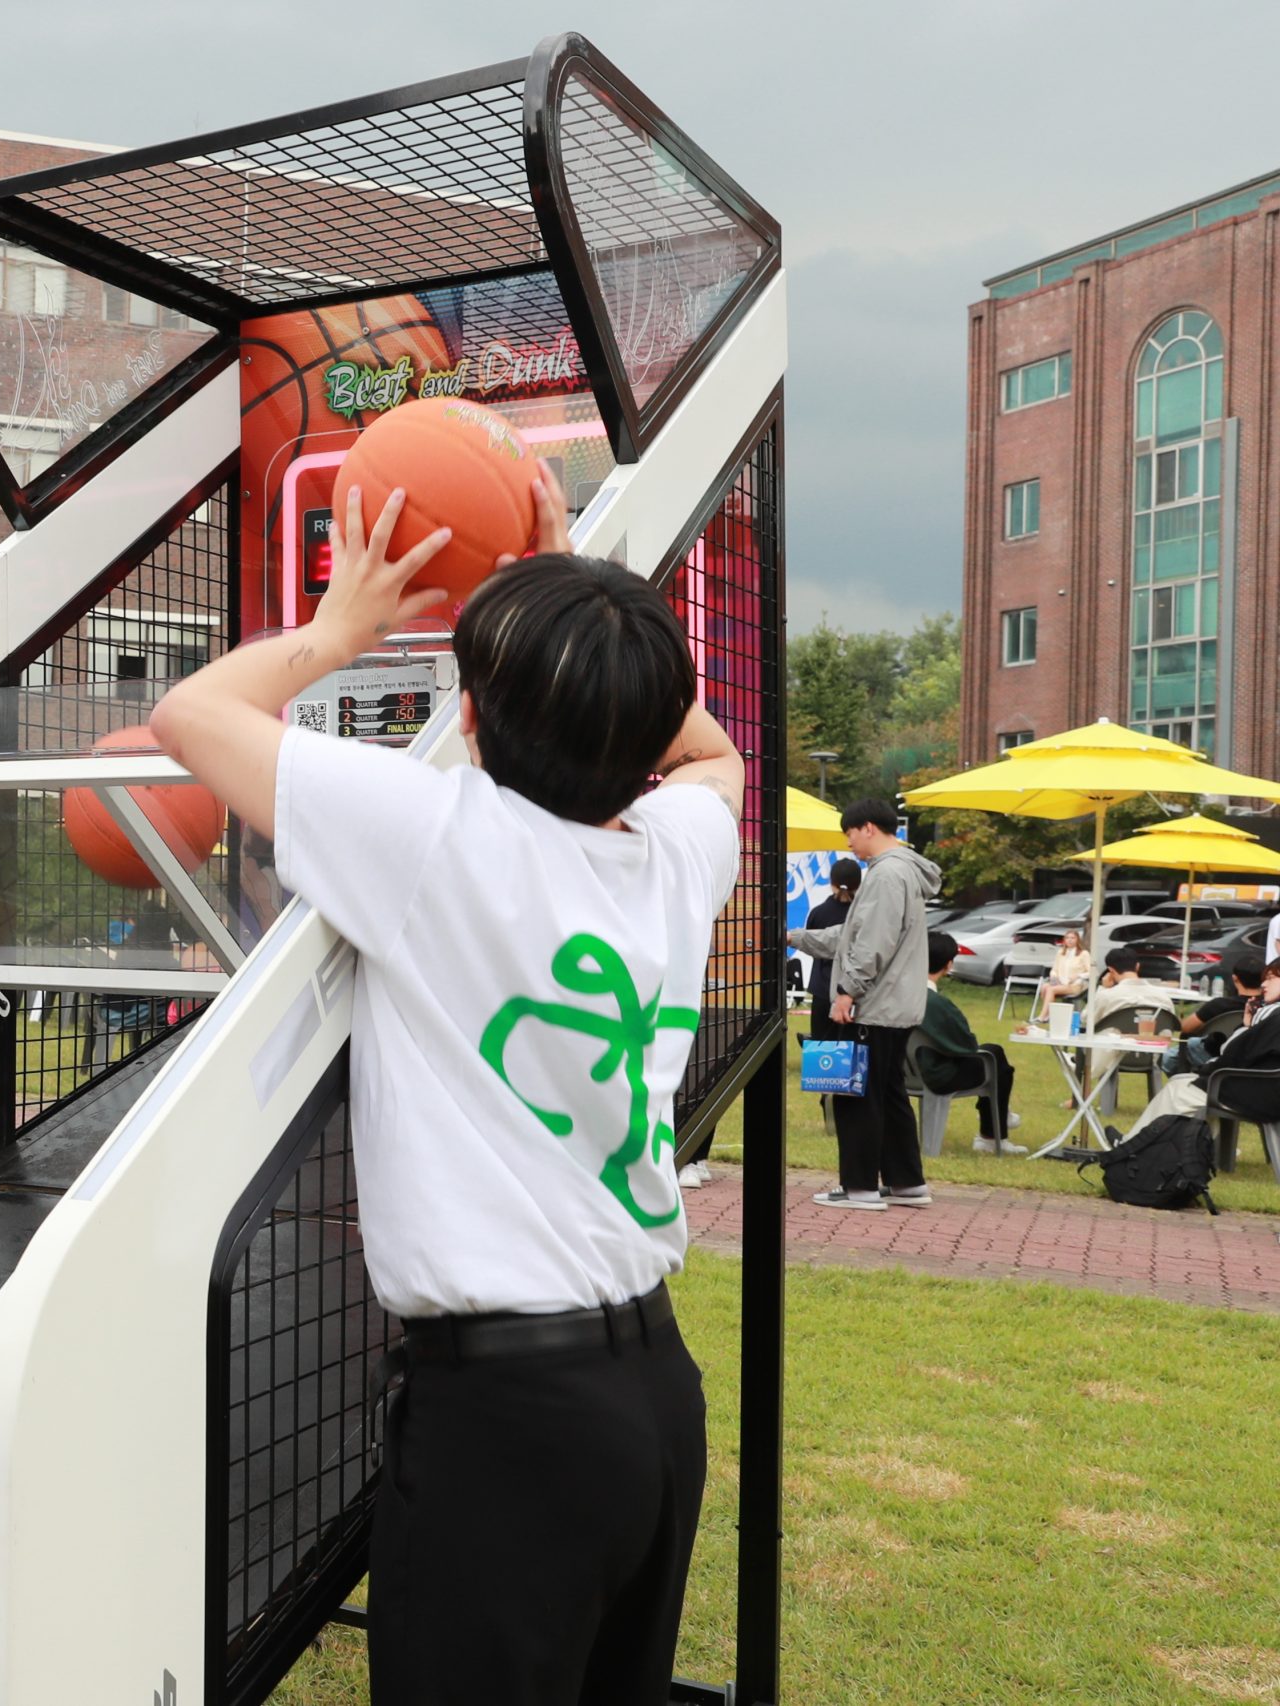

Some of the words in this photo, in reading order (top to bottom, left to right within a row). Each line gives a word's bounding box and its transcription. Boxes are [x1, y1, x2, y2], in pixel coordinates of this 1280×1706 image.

[326, 358, 411, 411] Beat
[421, 361, 466, 398] and
[481, 334, 577, 391] Dunk
[344, 698, 350, 708] 1
[399, 693, 415, 706] 50
[343, 712, 351, 722] 2
[395, 707, 415, 720] 150
[343, 726, 351, 736] 3
[386, 724, 405, 734] FINAL
[405, 722, 426, 733] ROUN
